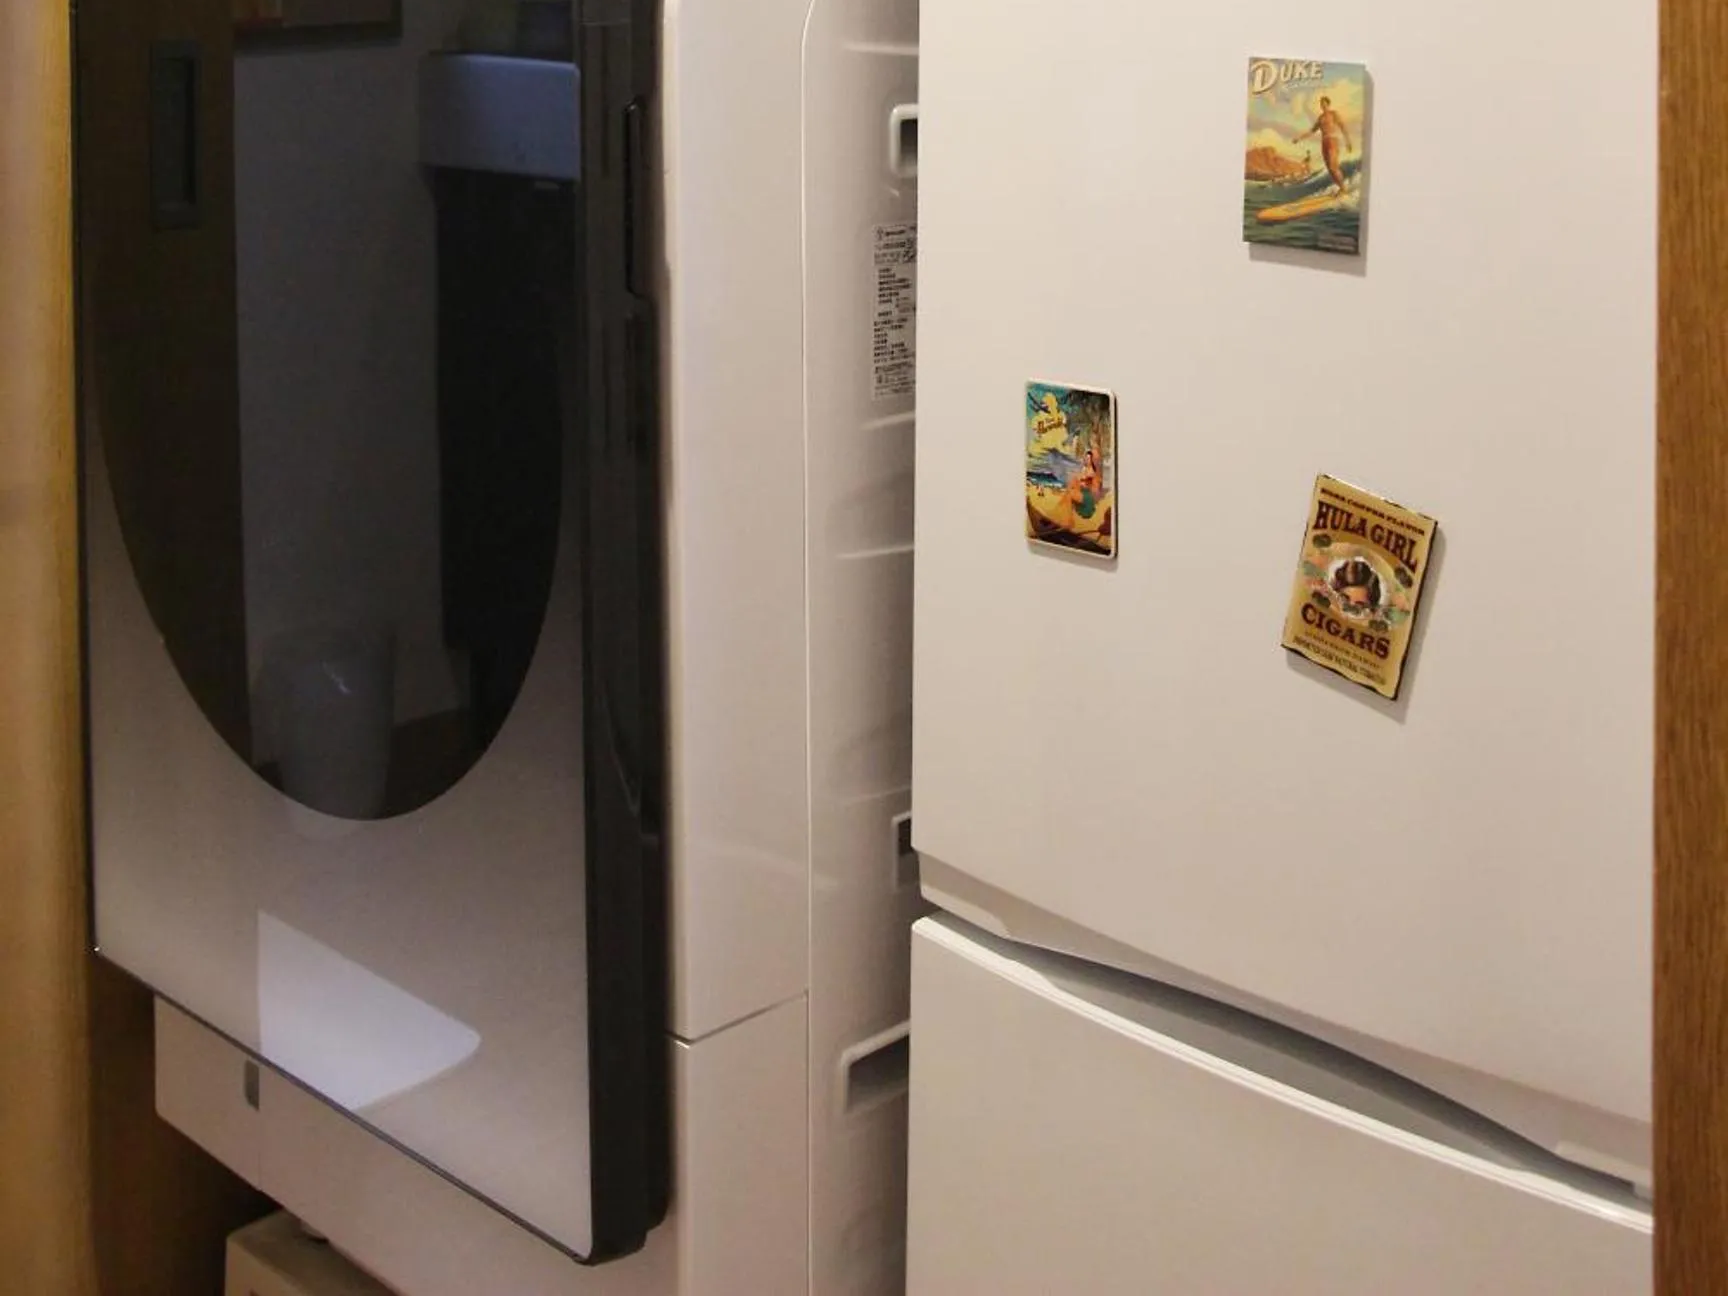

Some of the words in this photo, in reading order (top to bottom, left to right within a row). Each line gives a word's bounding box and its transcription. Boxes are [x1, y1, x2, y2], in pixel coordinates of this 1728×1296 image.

[1312, 500, 1368, 539] HULA
[1370, 523, 1418, 574] GIRL
[1301, 602, 1391, 660] CIGARS
